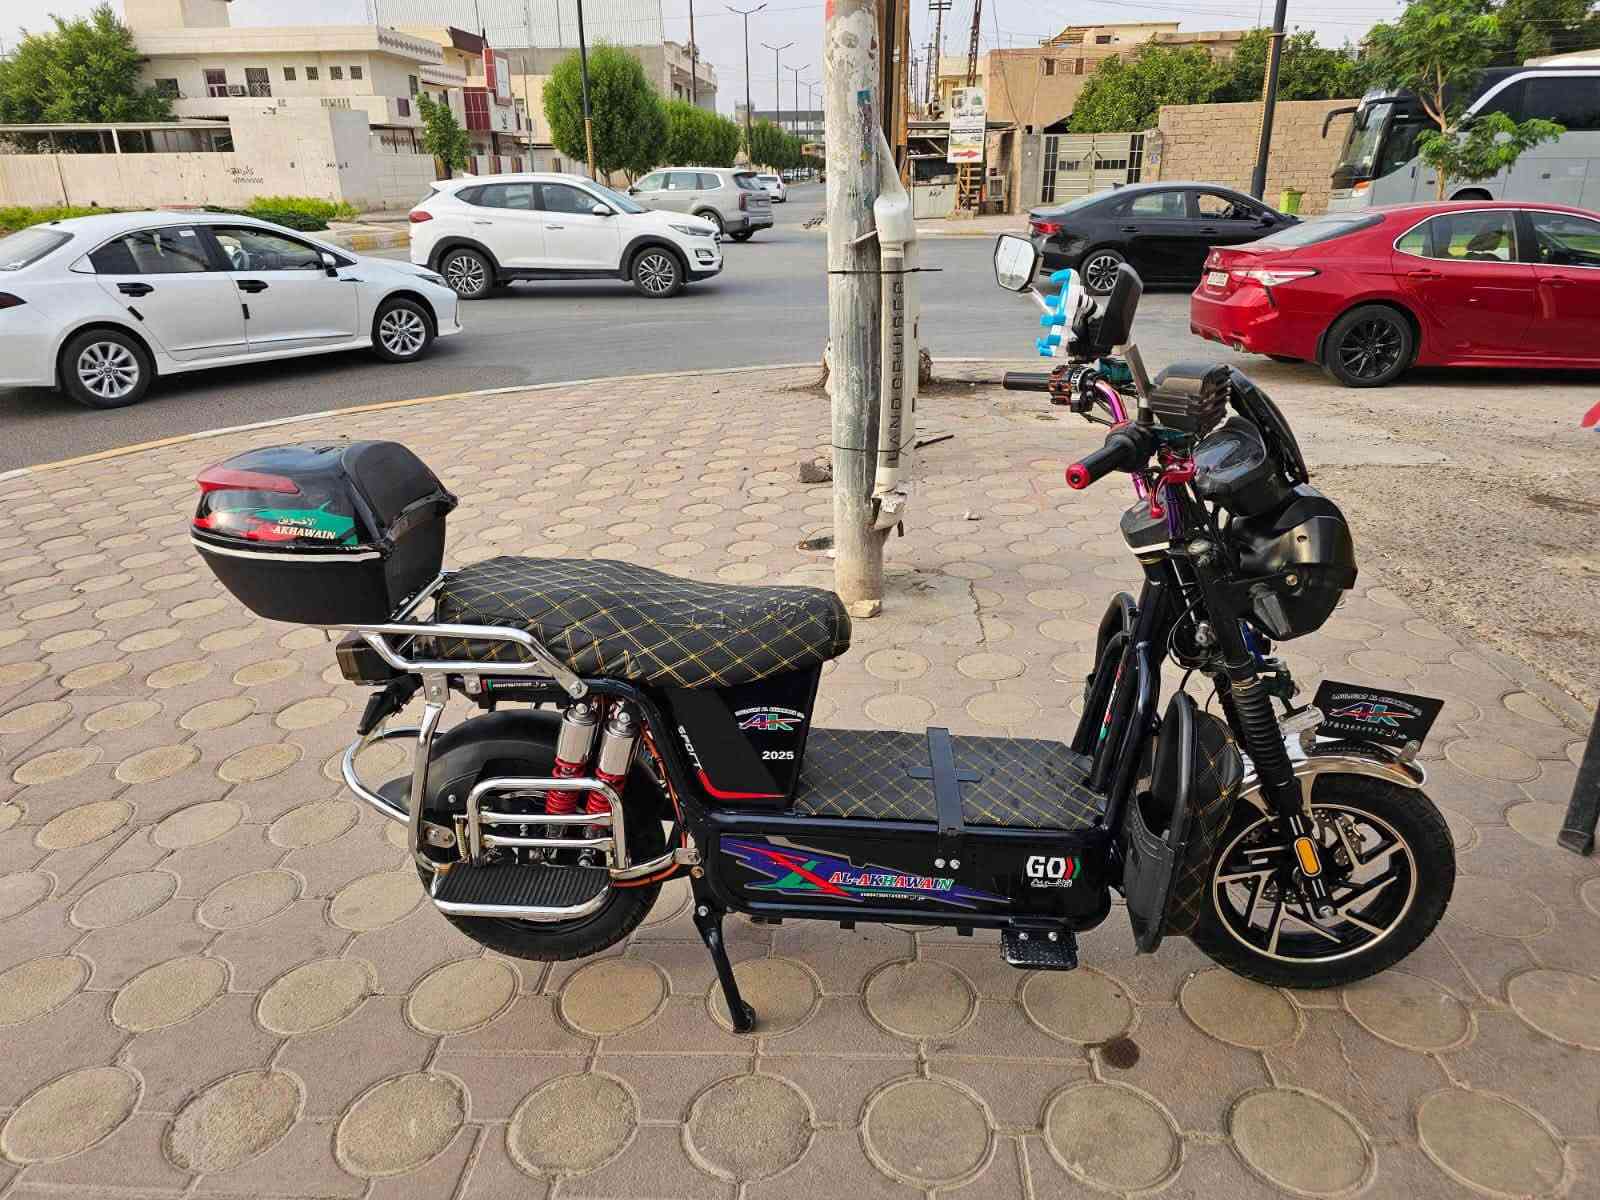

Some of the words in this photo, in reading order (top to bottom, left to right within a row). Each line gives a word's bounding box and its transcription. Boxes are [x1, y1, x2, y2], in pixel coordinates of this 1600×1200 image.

[892, 281, 904, 390] CRUISER
[887, 398, 901, 462] LAND
[272, 526, 336, 540] AKHAWAIN
[678, 725, 703, 769] SPORT
[762, 750, 794, 760] 2025
[1026, 856, 1066, 878] GO
[828, 872, 955, 891] AL-AKHAWAIN
